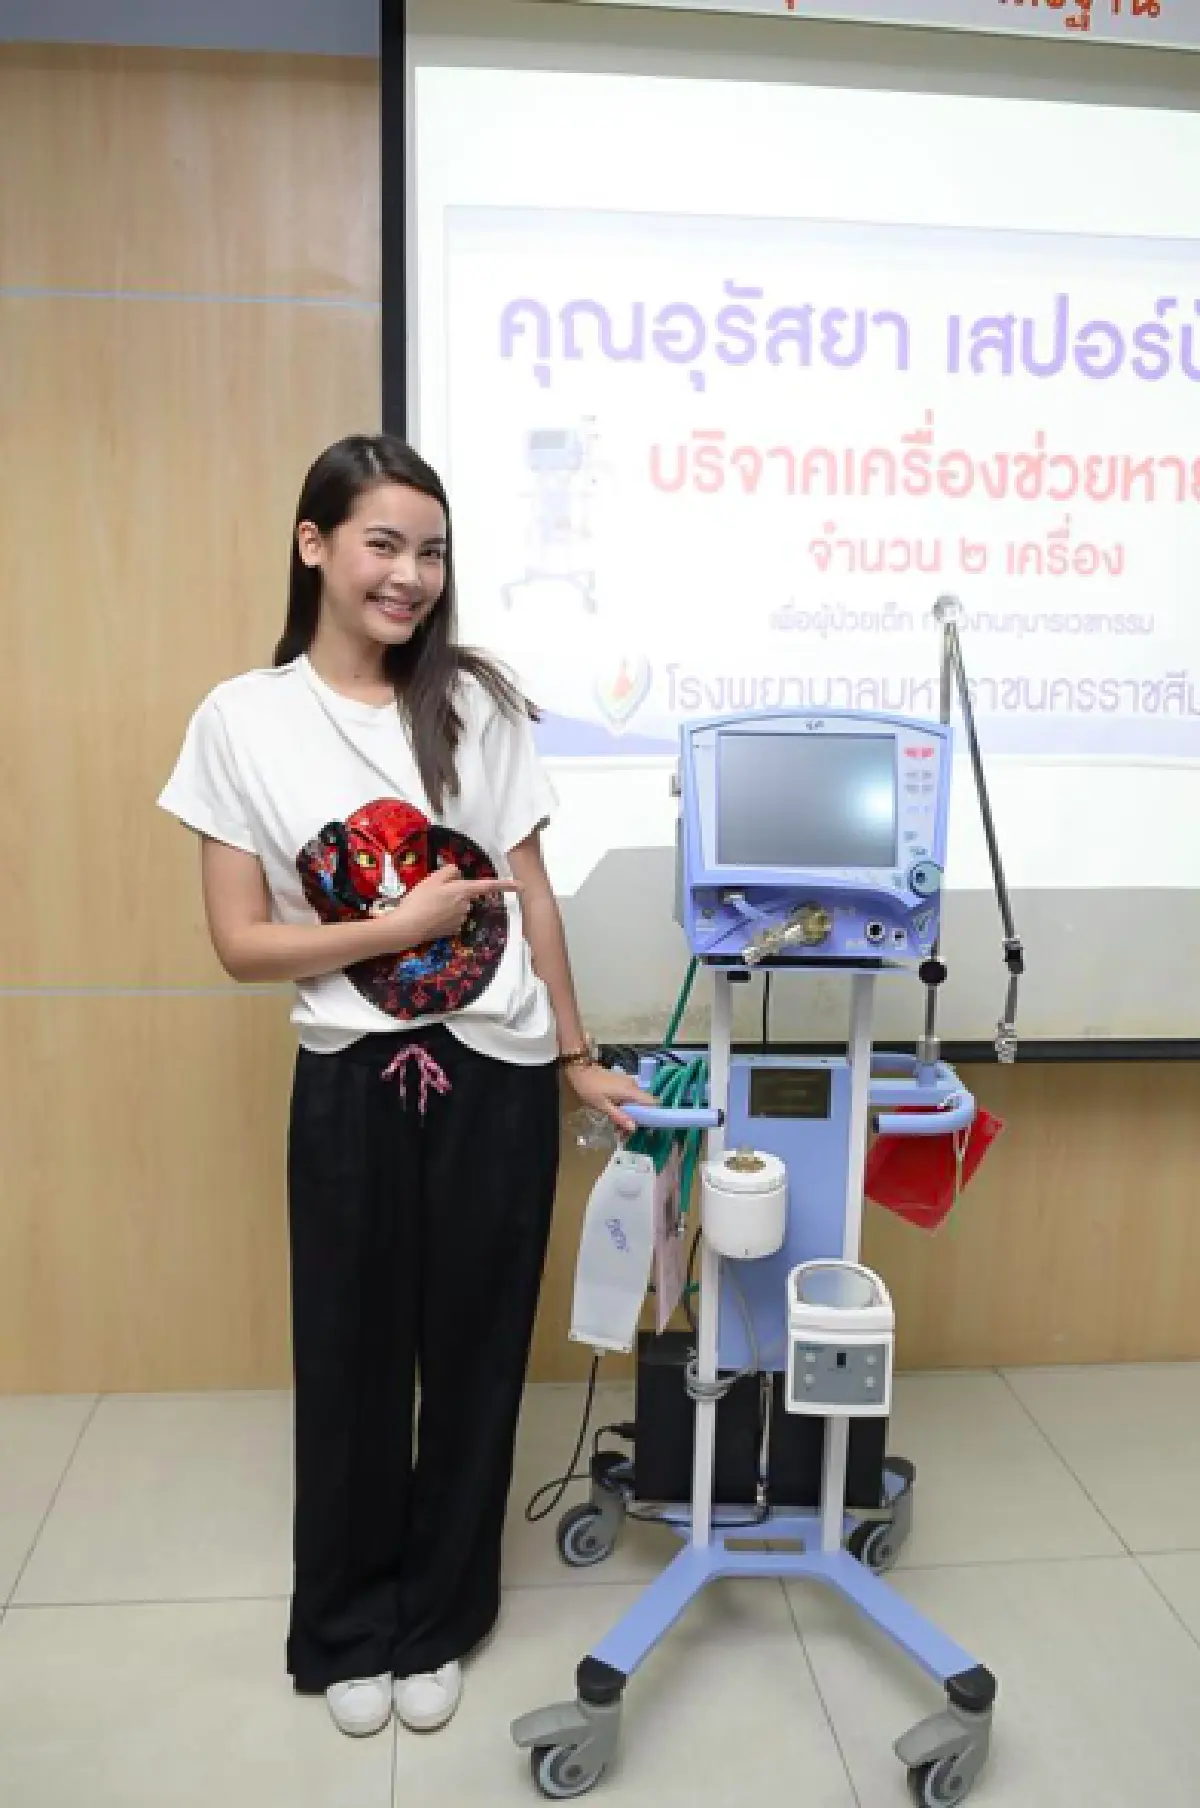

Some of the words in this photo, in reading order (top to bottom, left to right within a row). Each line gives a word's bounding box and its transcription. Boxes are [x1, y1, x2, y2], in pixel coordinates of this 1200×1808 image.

[499, 279, 910, 392] คุณอุรัสยา
[646, 408, 1200, 503] บริจาคเครื่องช่วยหา
[807, 519, 942, 574] จำนวน
[958, 536, 988, 575] ๒
[1004, 513, 1126, 578] เครื่อง
